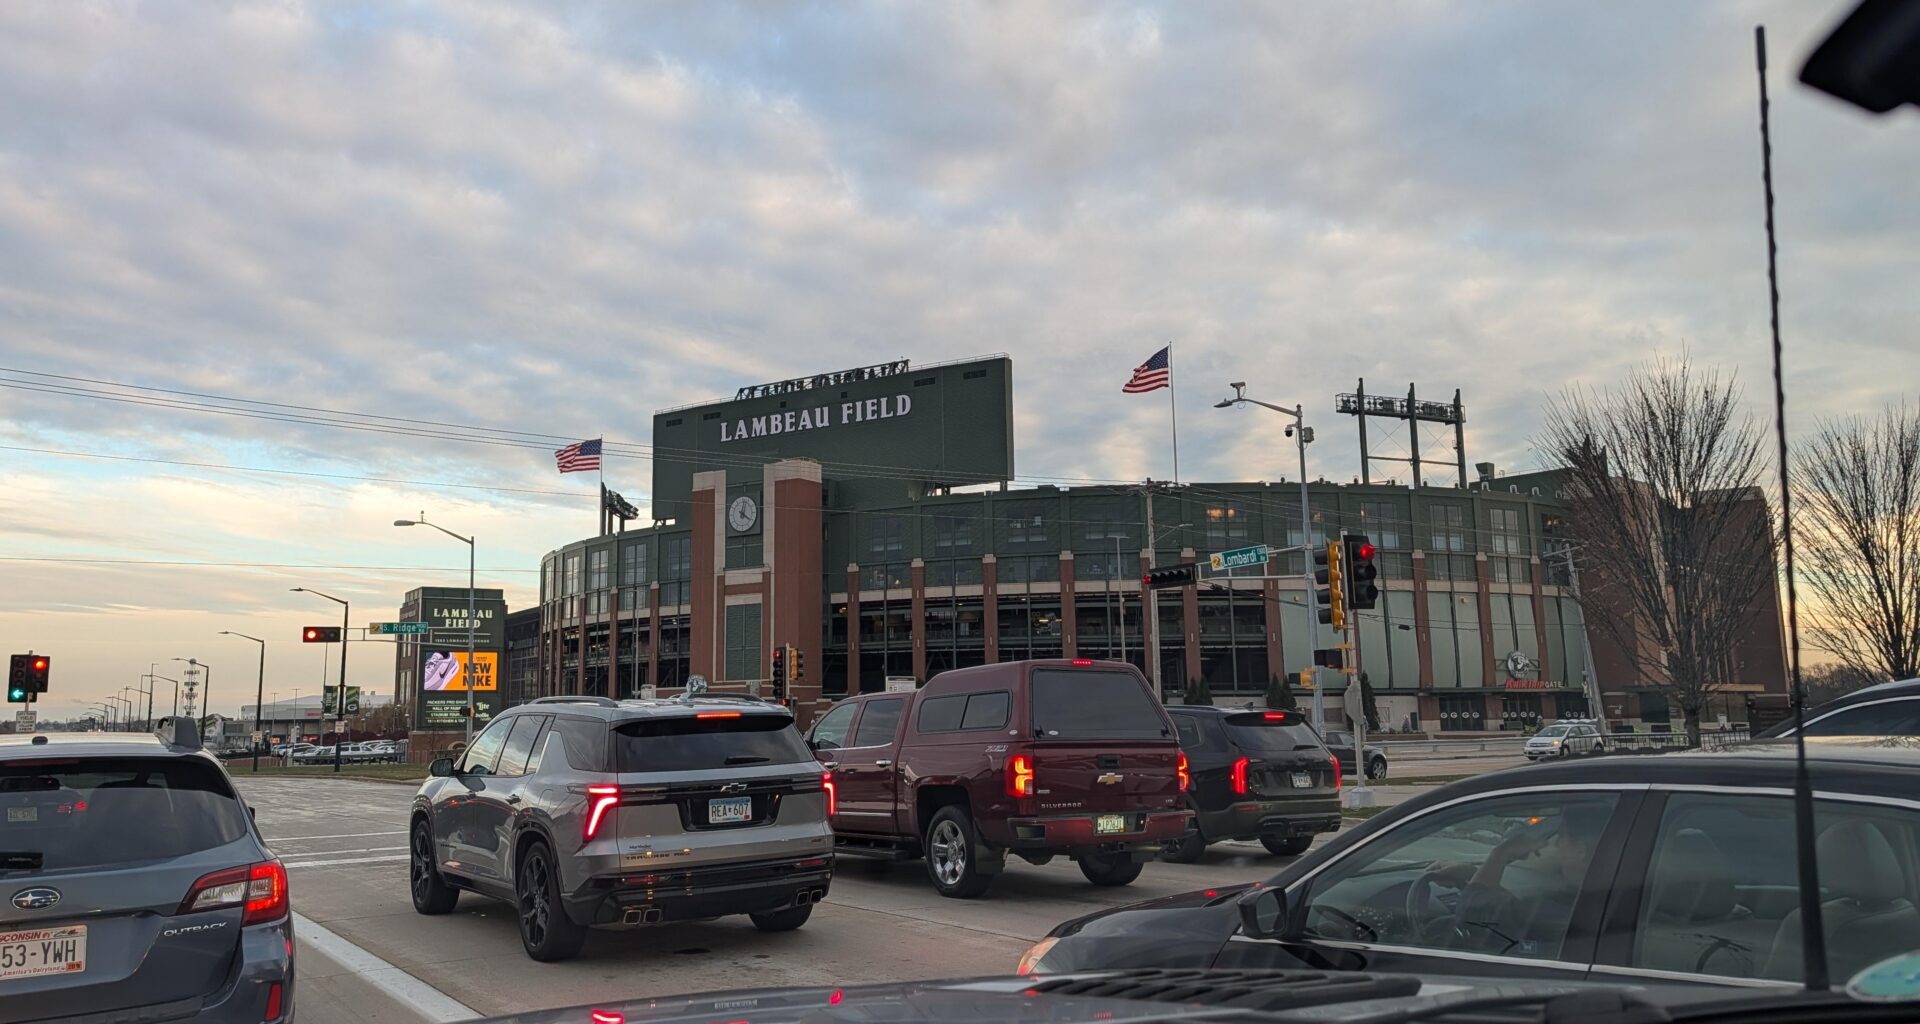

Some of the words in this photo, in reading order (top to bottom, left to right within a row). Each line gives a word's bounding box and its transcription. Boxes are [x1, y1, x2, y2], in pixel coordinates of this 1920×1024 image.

[720, 407, 830, 442] LAMBEAU
[841, 394, 912, 424] FIELD
[1223, 549, 1257, 566] Lombardi
[393, 624, 416, 633] Ridge
[464, 663, 492, 674] NEW
[462, 675, 491, 686] NIKE
[1545, 680, 1562, 689] GATE
[711, 805, 727, 817] REA
[733, 803, 748, 816] 607
[163, 922, 227, 937] OUTBACK
[1, 940, 76, 968] 53-YWH
